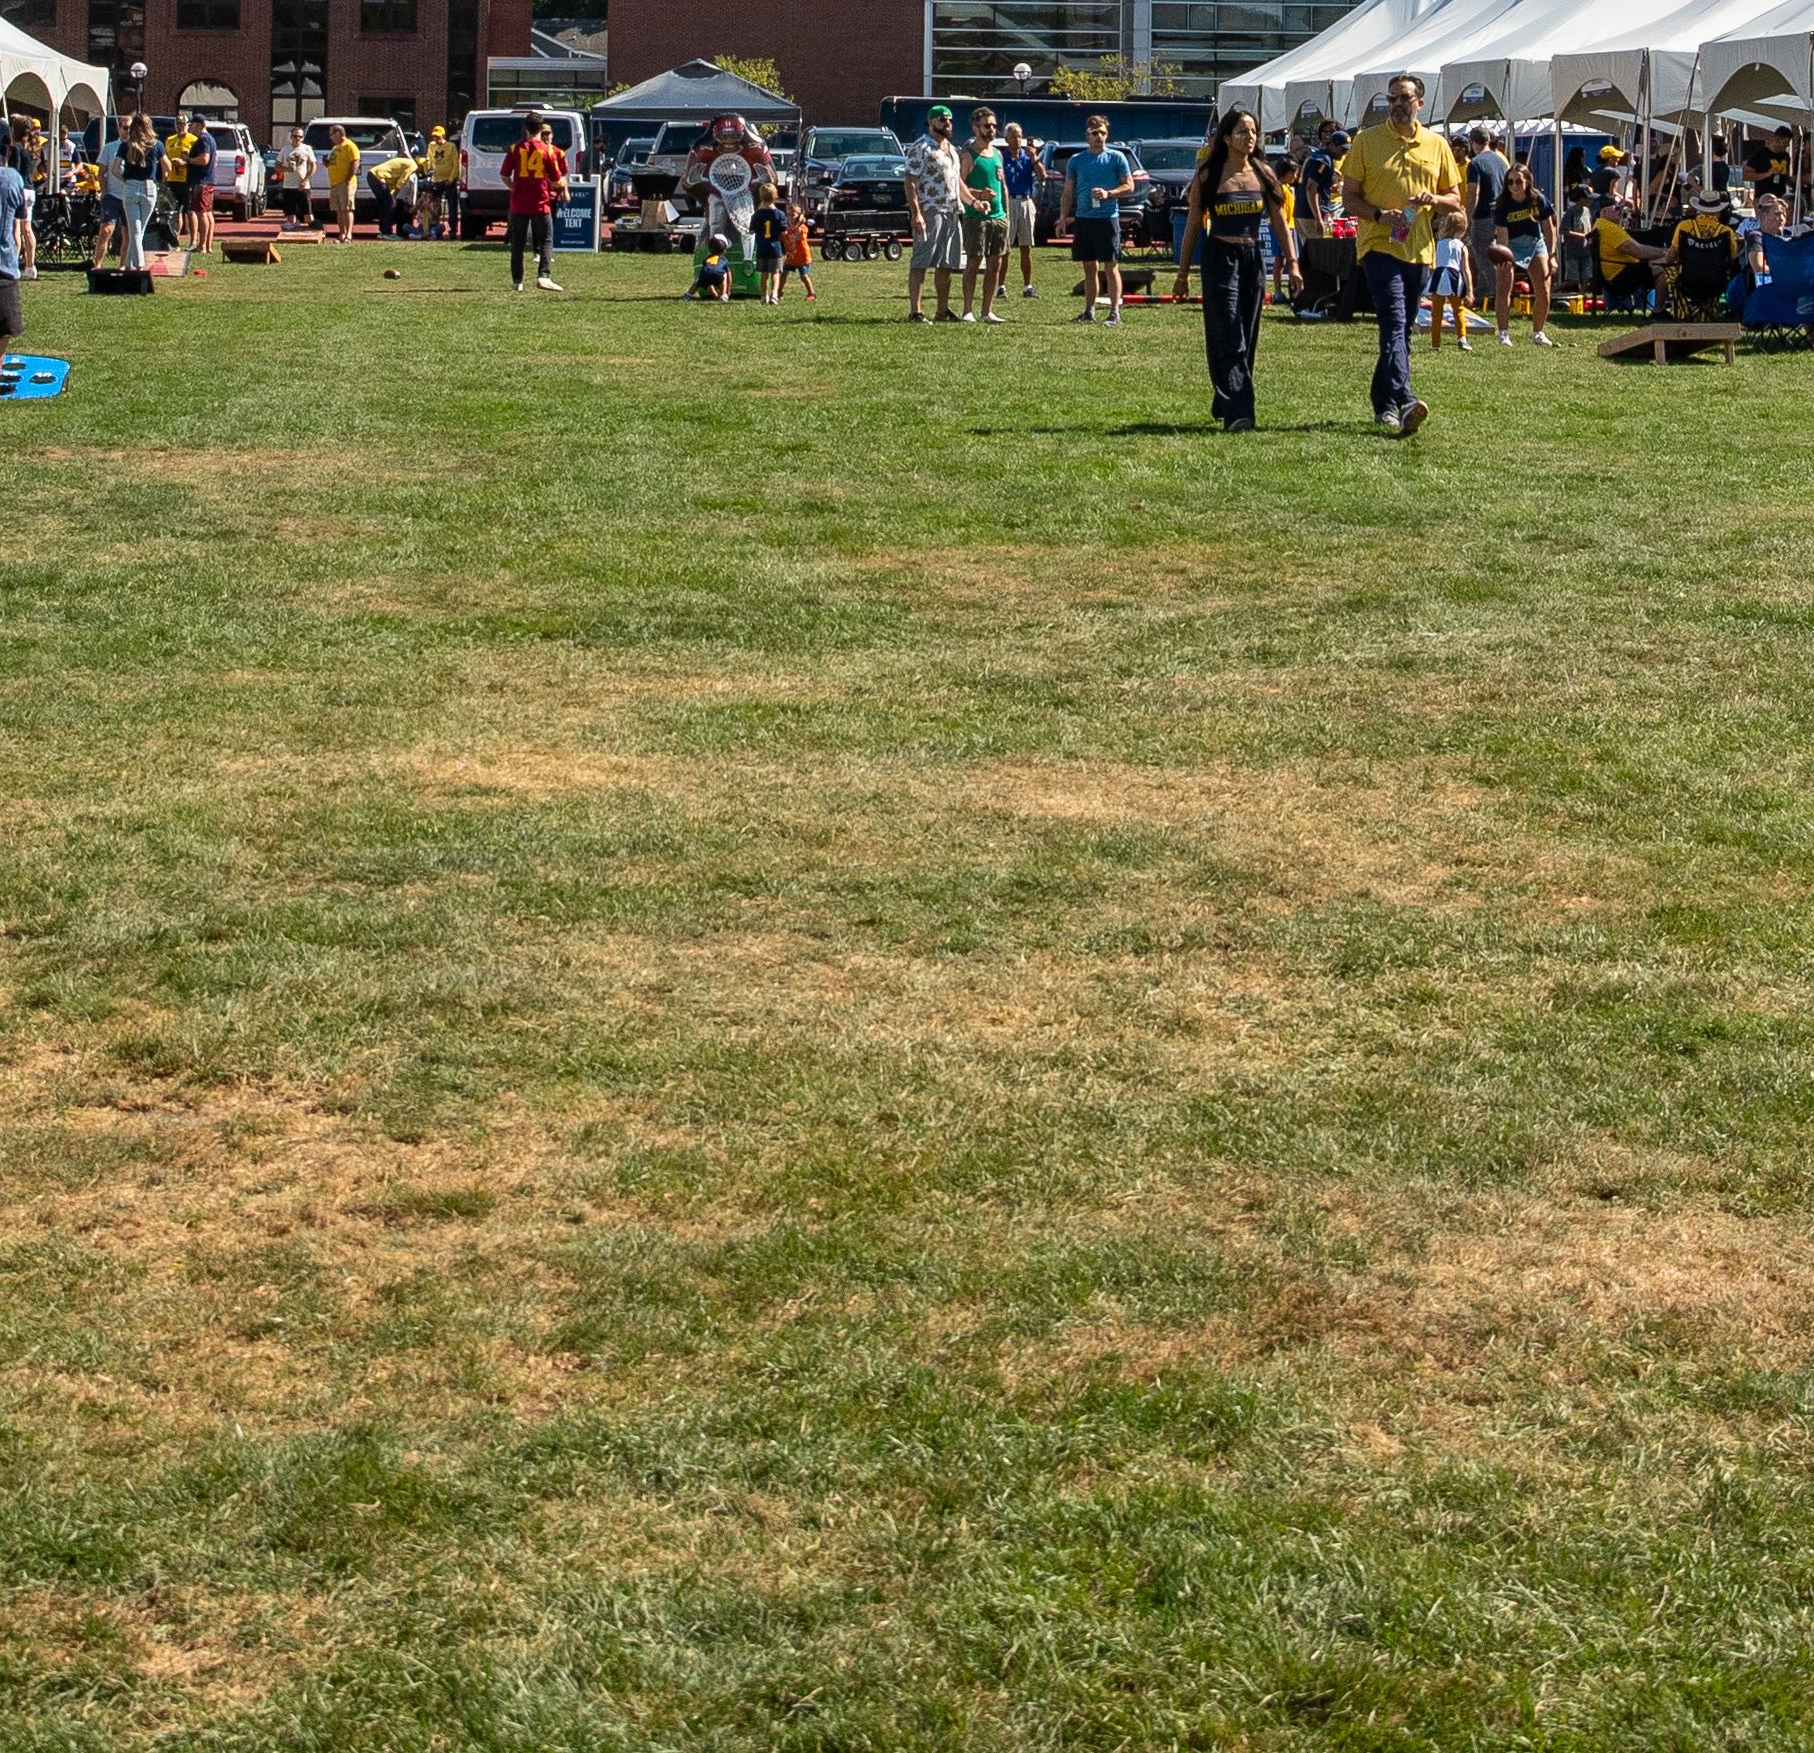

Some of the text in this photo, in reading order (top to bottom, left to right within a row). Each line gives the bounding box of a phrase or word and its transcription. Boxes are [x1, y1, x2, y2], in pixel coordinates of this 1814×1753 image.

[518, 147, 545, 179] 14
[556, 208, 592, 219] WELCOME
[1214, 199, 1263, 216] MICHIGAN
[565, 218, 582, 228] TENT
[763, 220, 772, 239] 1
